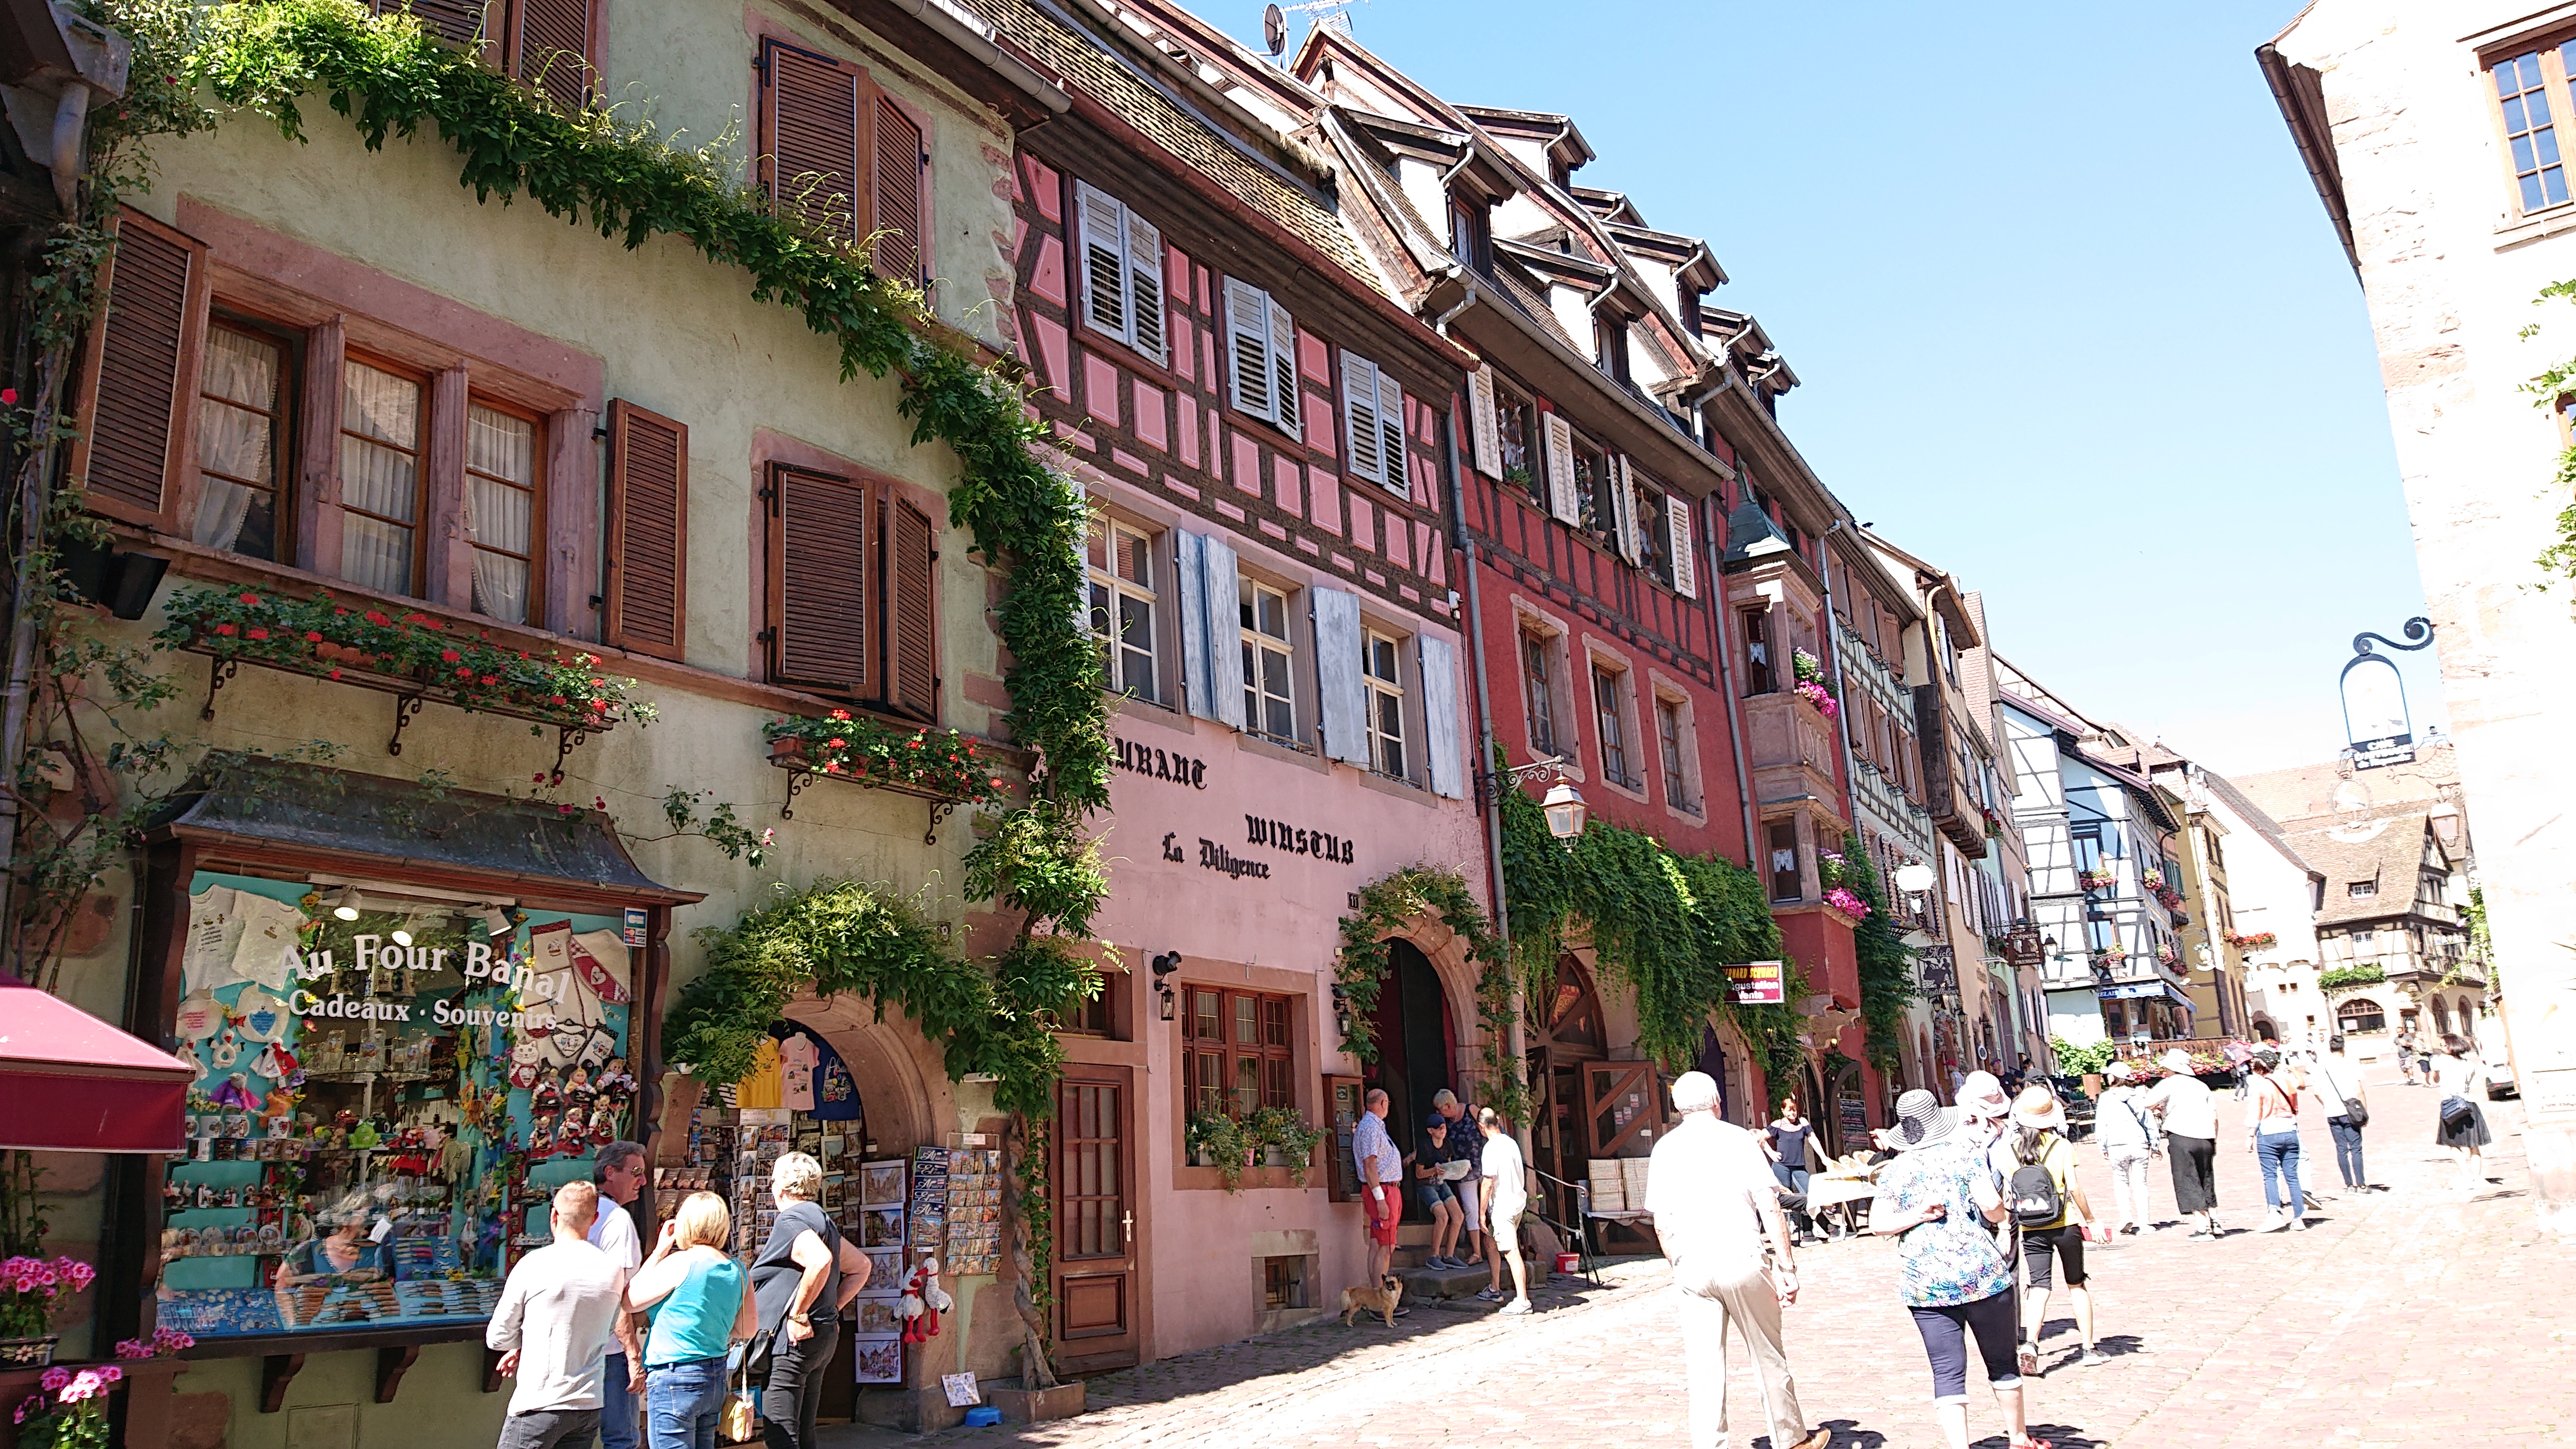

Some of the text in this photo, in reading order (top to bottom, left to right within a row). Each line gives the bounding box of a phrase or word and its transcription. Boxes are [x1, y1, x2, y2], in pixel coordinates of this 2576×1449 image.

[1108, 737, 1208, 790] URANT
[1162, 832, 1271, 880] La Diligence
[1245, 813, 1354, 865] WINSTUB
[280, 934, 571, 1005] Au Four Banal
[1722, 967, 1748, 979] ERNARD
[1733, 980, 1779, 991] gustation
[288, 989, 558, 1030] Cadeaux Souvenirs
[1738, 990, 1764, 999] Vente
